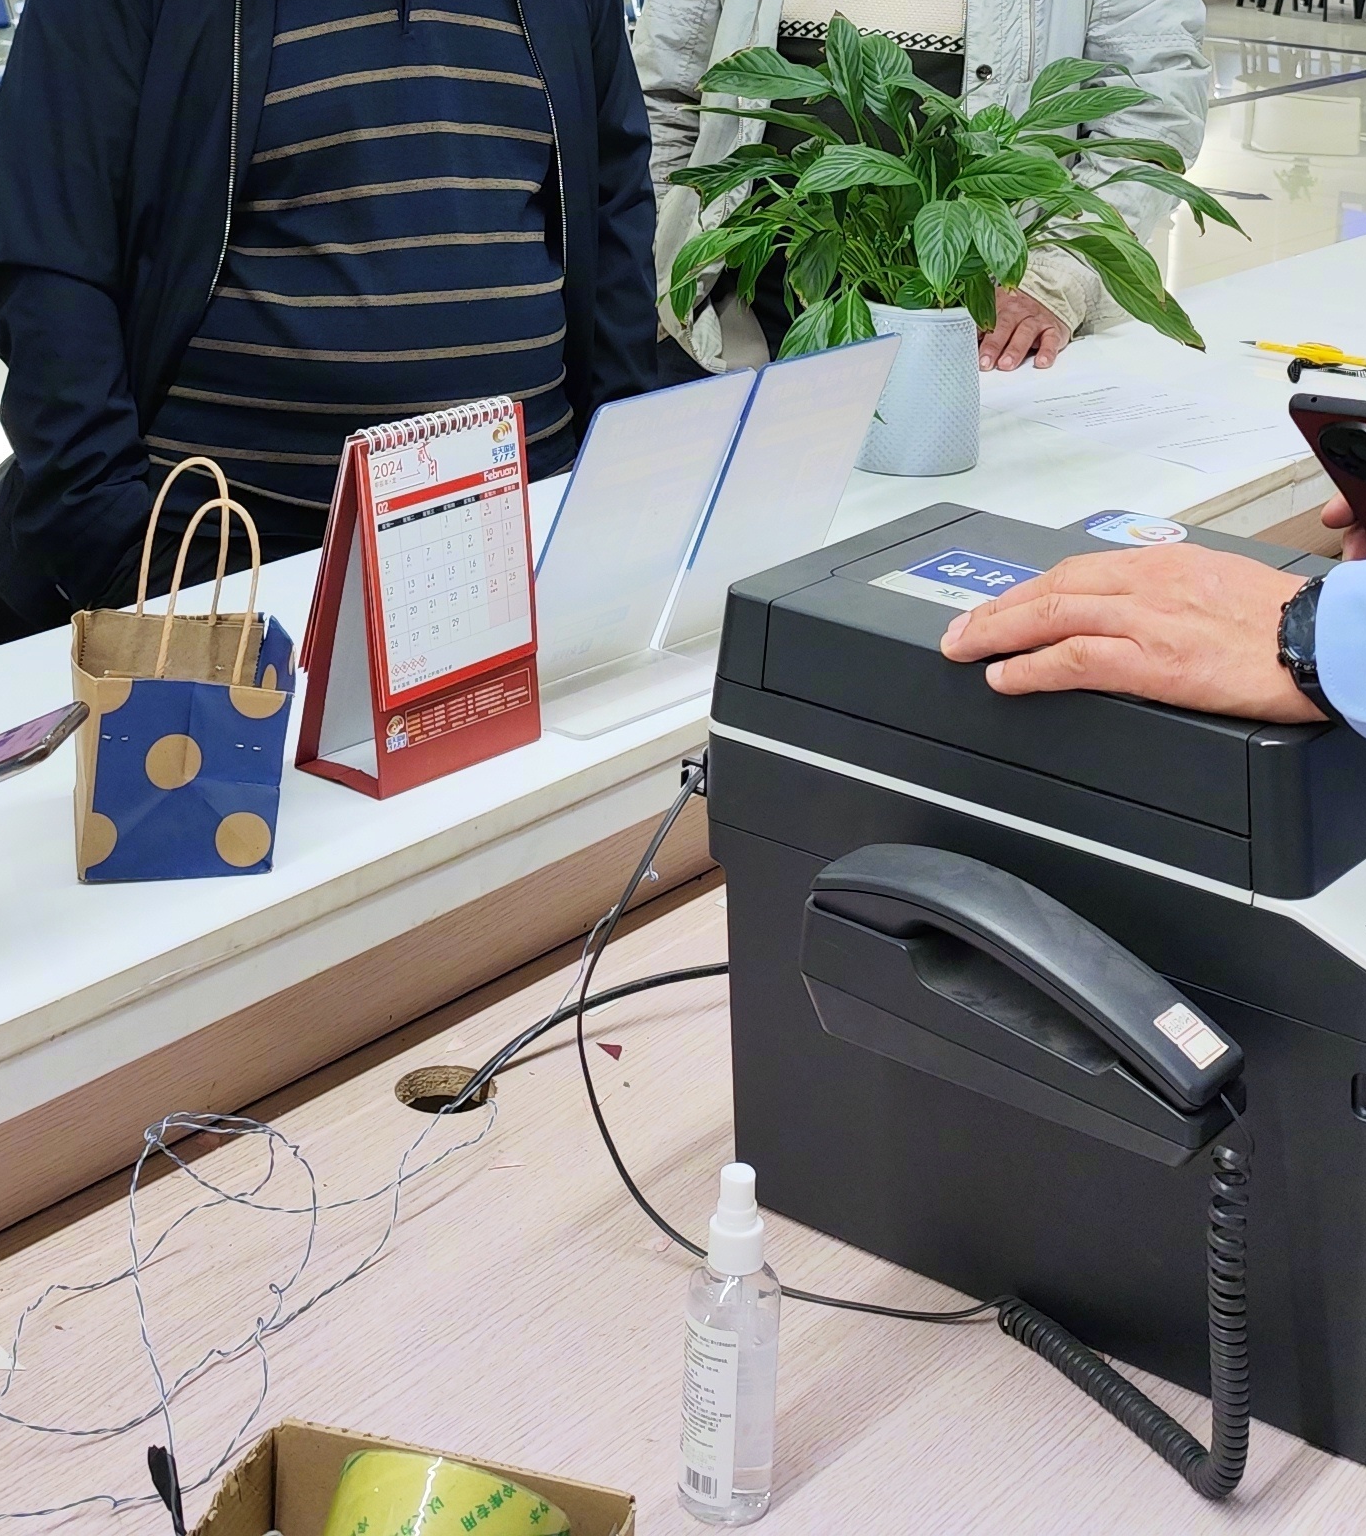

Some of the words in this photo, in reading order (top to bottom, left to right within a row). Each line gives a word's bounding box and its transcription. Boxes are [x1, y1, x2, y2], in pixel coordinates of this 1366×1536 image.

[373, 458, 403, 480] 2024
[493, 452, 516, 463] SITS
[483, 466, 517, 482] February
[377, 502, 389, 514] 02
[466, 509, 471, 517] 2
[486, 503, 489, 511] 3
[385, 561, 389, 569] 5
[407, 554, 411, 562] 6
[426, 548, 430, 556] 7
[447, 541, 451, 549] 8
[486, 528, 493, 536] 10
[505, 522, 512, 530] 11
[386, 587, 393, 595] 12
[408, 580, 415, 588] 13
[427, 573, 434, 582] 14
[448, 566, 455, 575] 15
[469, 560, 476, 568] 16
[488, 553, 494, 561] 17
[507, 547, 514, 555] 18
[937, 560, 1018, 587] 打印
[389, 613, 395, 622] 19
[410, 606, 417, 615] 20
[429, 599, 436, 608] 21
[450, 592, 457, 601] 22
[471, 585, 478, 594] 23
[490, 579, 497, 587] 24
[509, 572, 516, 580] 25
[391, 639, 398, 649] 26
[412, 632, 419, 641] 27
[432, 625, 439, 634] 28
[452, 618, 459, 627] 29
